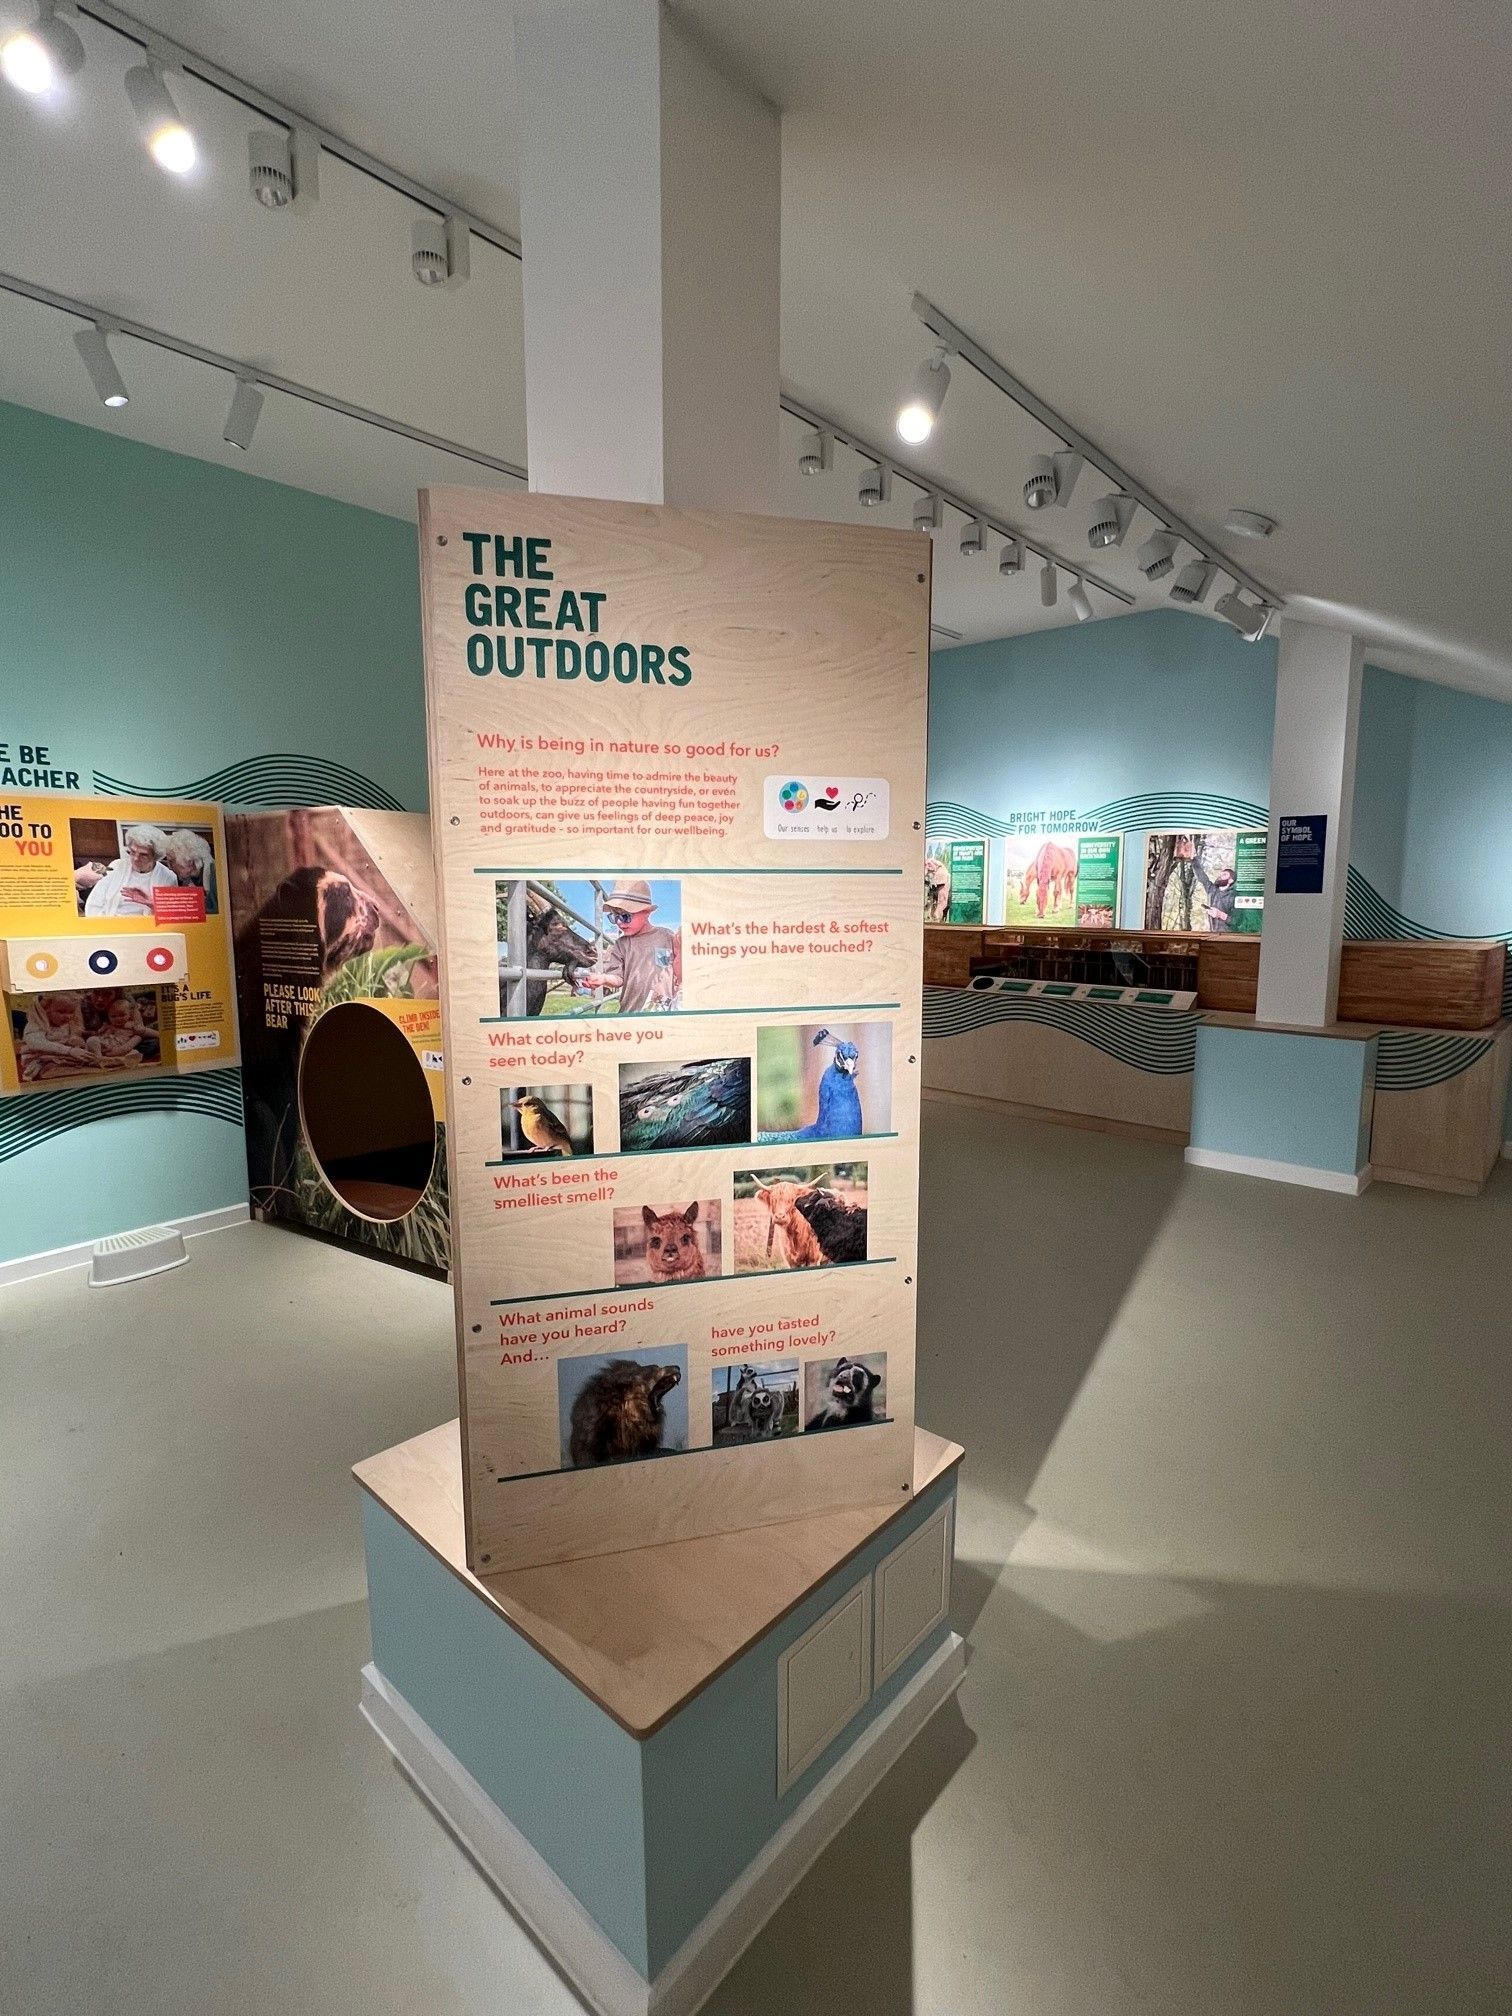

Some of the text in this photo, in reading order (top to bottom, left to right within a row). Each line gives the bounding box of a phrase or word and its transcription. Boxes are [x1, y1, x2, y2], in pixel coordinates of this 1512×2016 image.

[463, 532, 554, 580] THE
[465, 583, 607, 632] GREAT
[467, 633, 692, 686] OUTDOORS
[19, 745, 50, 765] BE
[477, 734, 780, 759] Why is being in nature so good for us?
[1, 767, 80, 790] ACHER
[478, 767, 505, 777] Here
[508, 769, 518, 777] at
[522, 768, 539, 778] the
[542, 771, 565, 779] zoo,
[568, 769, 603, 781] having
[607, 770, 629, 780] time
[646, 771, 681, 782] admire
[685, 772, 700, 782] the
[704, 773, 738, 785] beauty
[479, 781, 490, 791] of
[493, 782, 539, 793] animals,
[541, 784, 551, 792] to
[556, 784, 611, 795] appreciate
[615, 784, 631, 793] the
[635, 785, 696, 797] countryside,
[479, 796, 740, 812] to soak up the buzz of people having fun together
[0, 806, 23, 820] HE
[480, 809, 734, 824] outdoors, can give us feelings of deep peace, joy
[1010, 810, 1076, 823] BRIGHT HOPE
[28, 823, 52, 838] TO
[480, 823, 502, 833] and
[505, 823, 556, 835] gratitude
[582, 825, 634, 836] important
[637, 825, 651, 834] for
[674, 826, 727, 837] wellbeing.
[778, 824, 788, 832] Our
[817, 825, 829, 834] help
[853, 825, 875, 834] explore
[1018, 821, 1099, 834] FOR TOMORROW
[1282, 826, 1312, 834] SYMBOL
[16, 841, 52, 856] YOU
[692, 920, 889, 935] What's the hardest & softest
[691, 940, 873, 958] things you have touched?
[183, 984, 189, 992] A
[190, 991, 211, 1000] LIFE
[263, 983, 321, 1002] PLEASE LOOK
[265, 999, 314, 1017] AFTER THIS
[265, 1013, 288, 1029] BEAR
[488, 1029, 663, 1047] What colours have you
[489, 1051, 584, 1067] seen today?
[494, 1168, 618, 1189] What's been the
[494, 1188, 615, 1210] smelliest smell?
[499, 1298, 654, 1327] What animal sounds
[500, 1319, 627, 1346] have you heard?
[712, 1314, 820, 1339] have you tasted
[711, 1330, 836, 1357] something lovely?
[500, 1349, 549, 1365] And...
